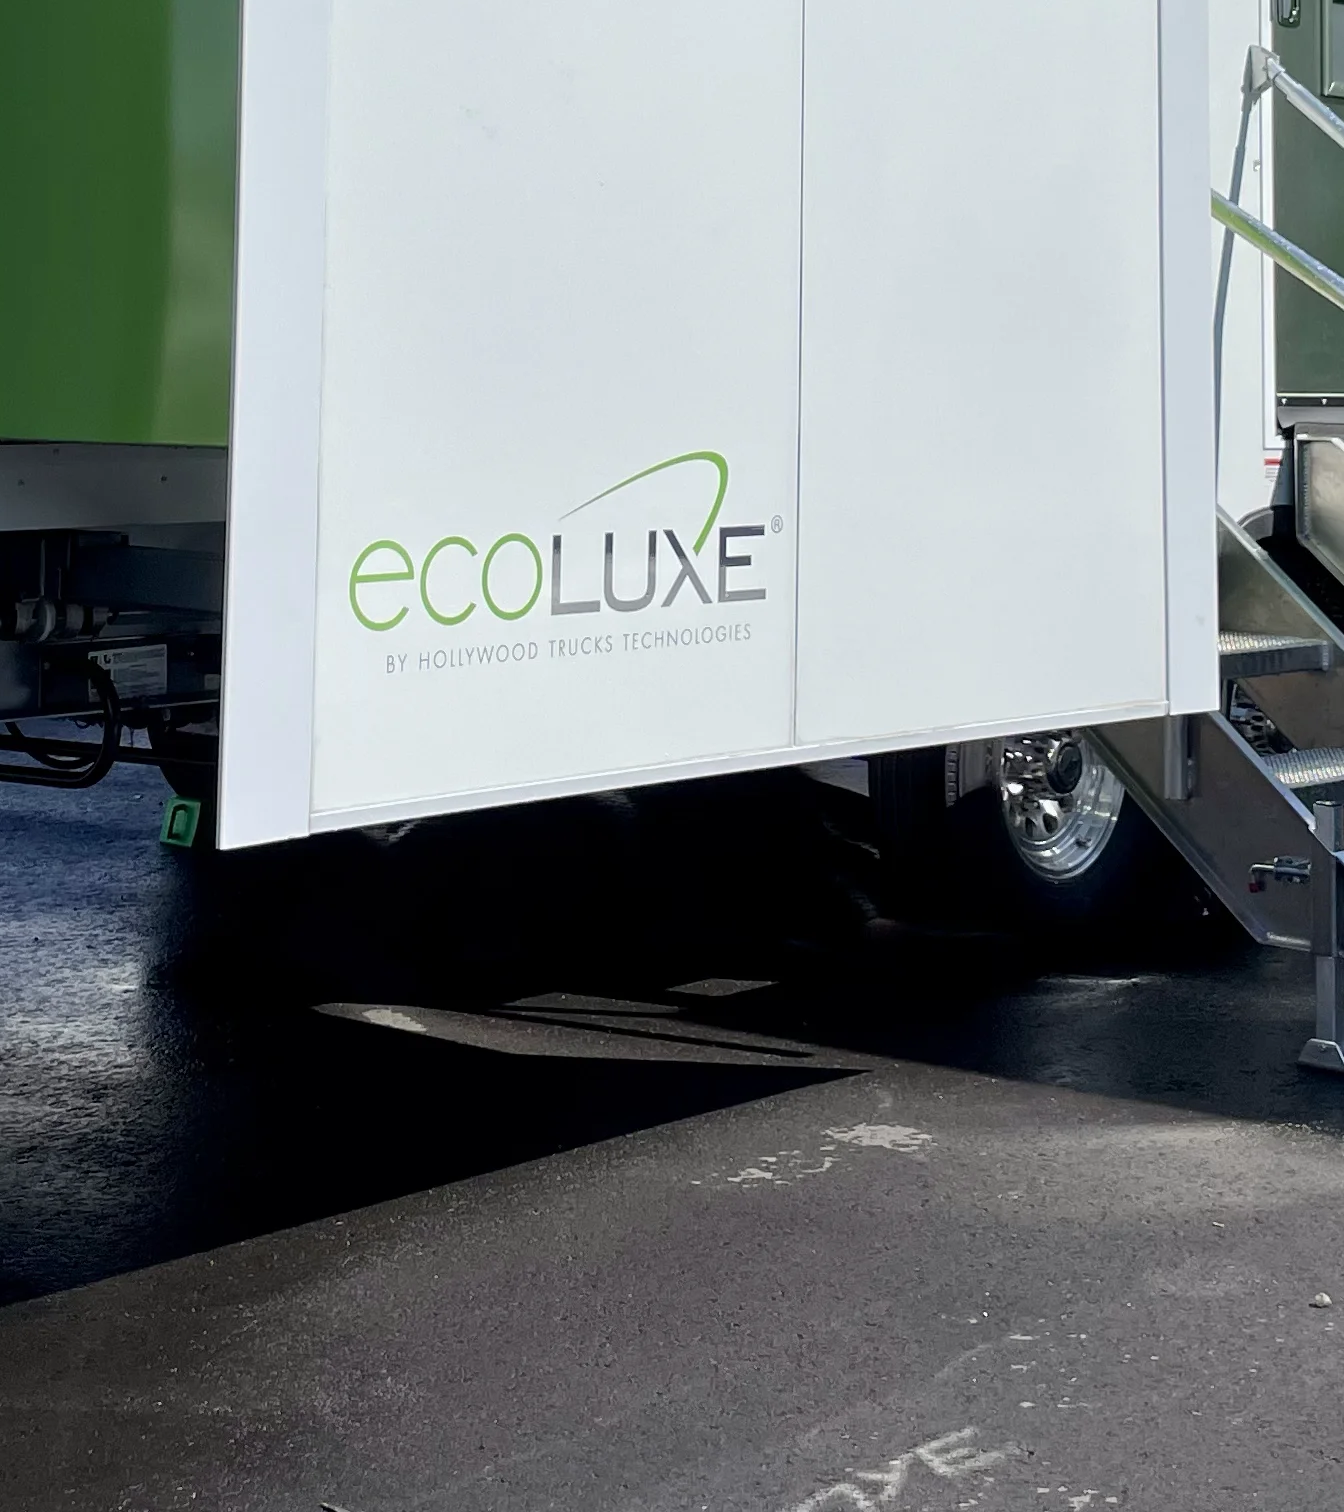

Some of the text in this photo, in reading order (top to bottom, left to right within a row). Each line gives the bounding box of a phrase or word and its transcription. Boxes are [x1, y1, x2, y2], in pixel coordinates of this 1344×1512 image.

[386, 623, 752, 674] BY HOLLYWOOD TRUCKS TECHNOLOGIES
